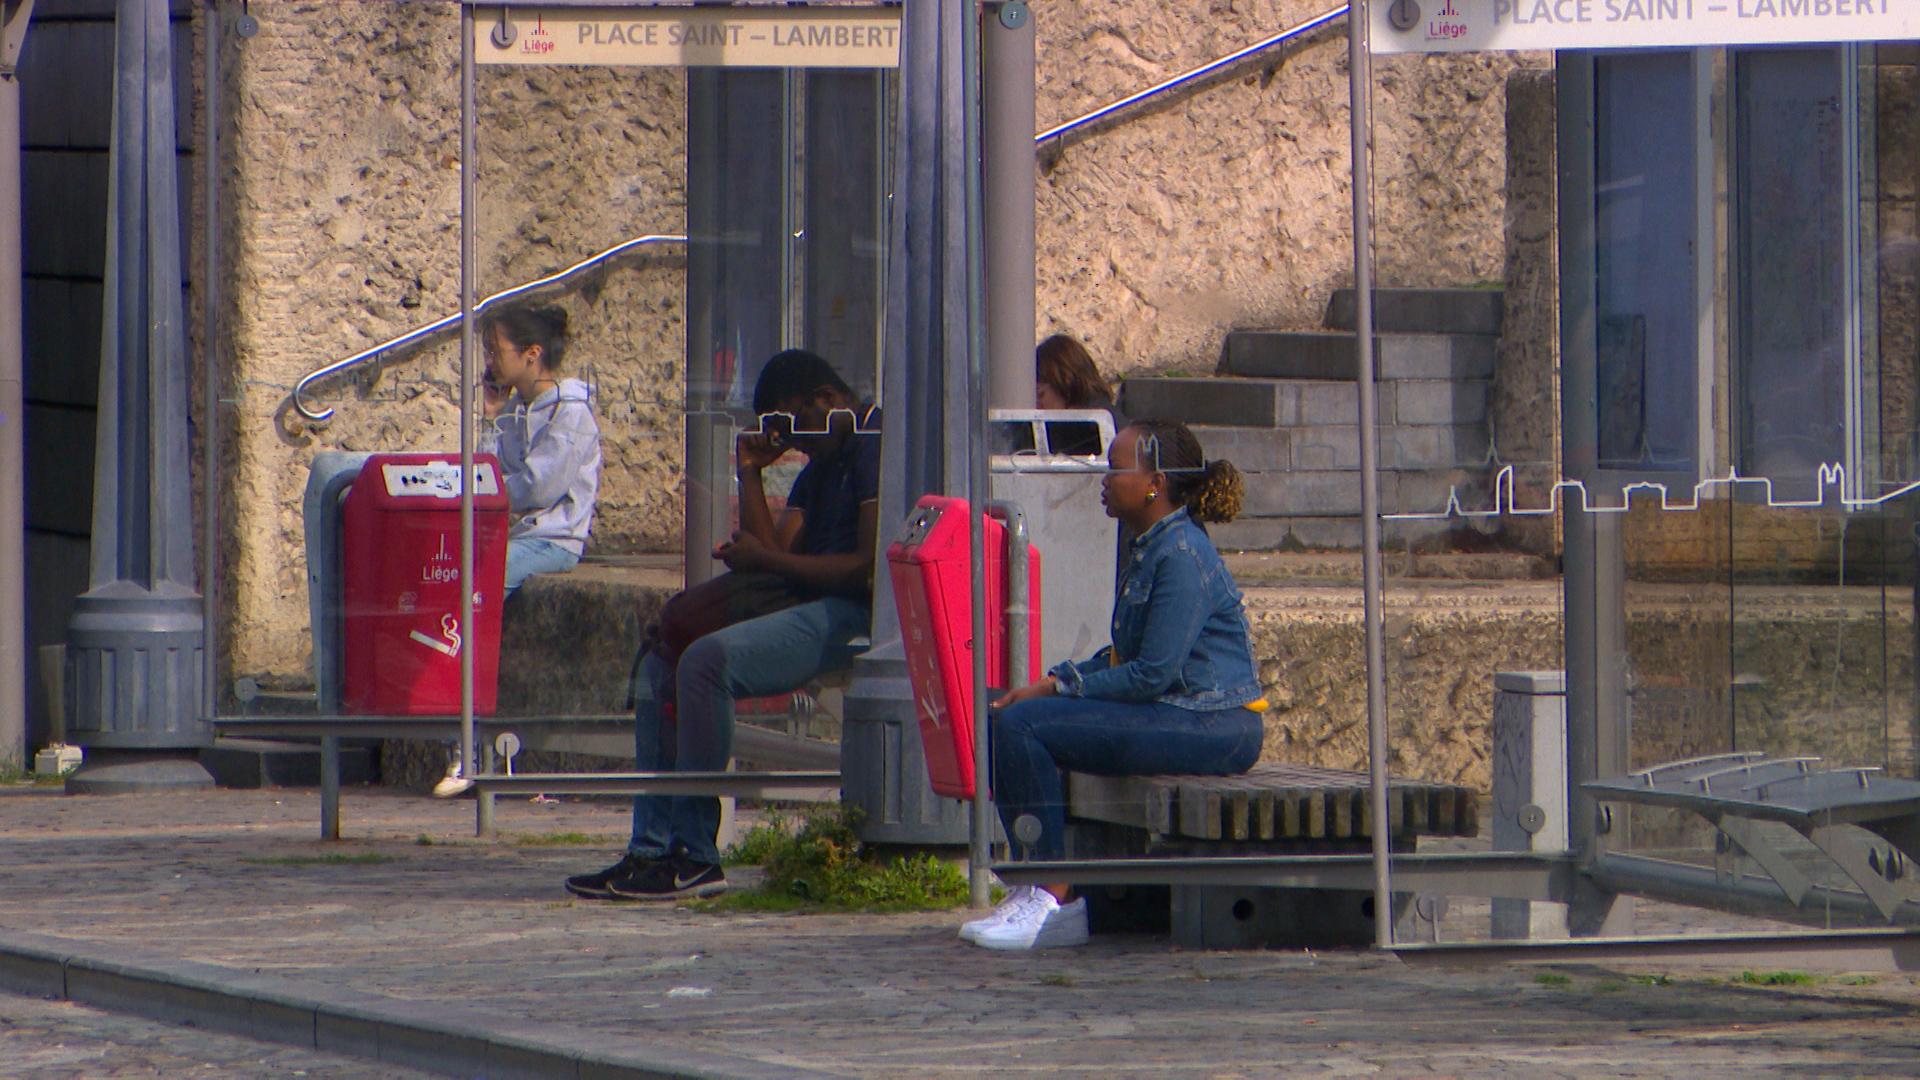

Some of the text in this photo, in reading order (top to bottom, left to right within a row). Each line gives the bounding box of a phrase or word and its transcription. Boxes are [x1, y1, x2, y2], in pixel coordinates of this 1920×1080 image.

[1493, 0, 1592, 24] PLACE
[1605, 0, 1693, 21] SAINT
[578, 23, 658, 45] PLACE
[668, 23, 745, 46] SAINT
[772, 25, 899, 48] LAMBERT
[422, 565, 459, 583] Liège
